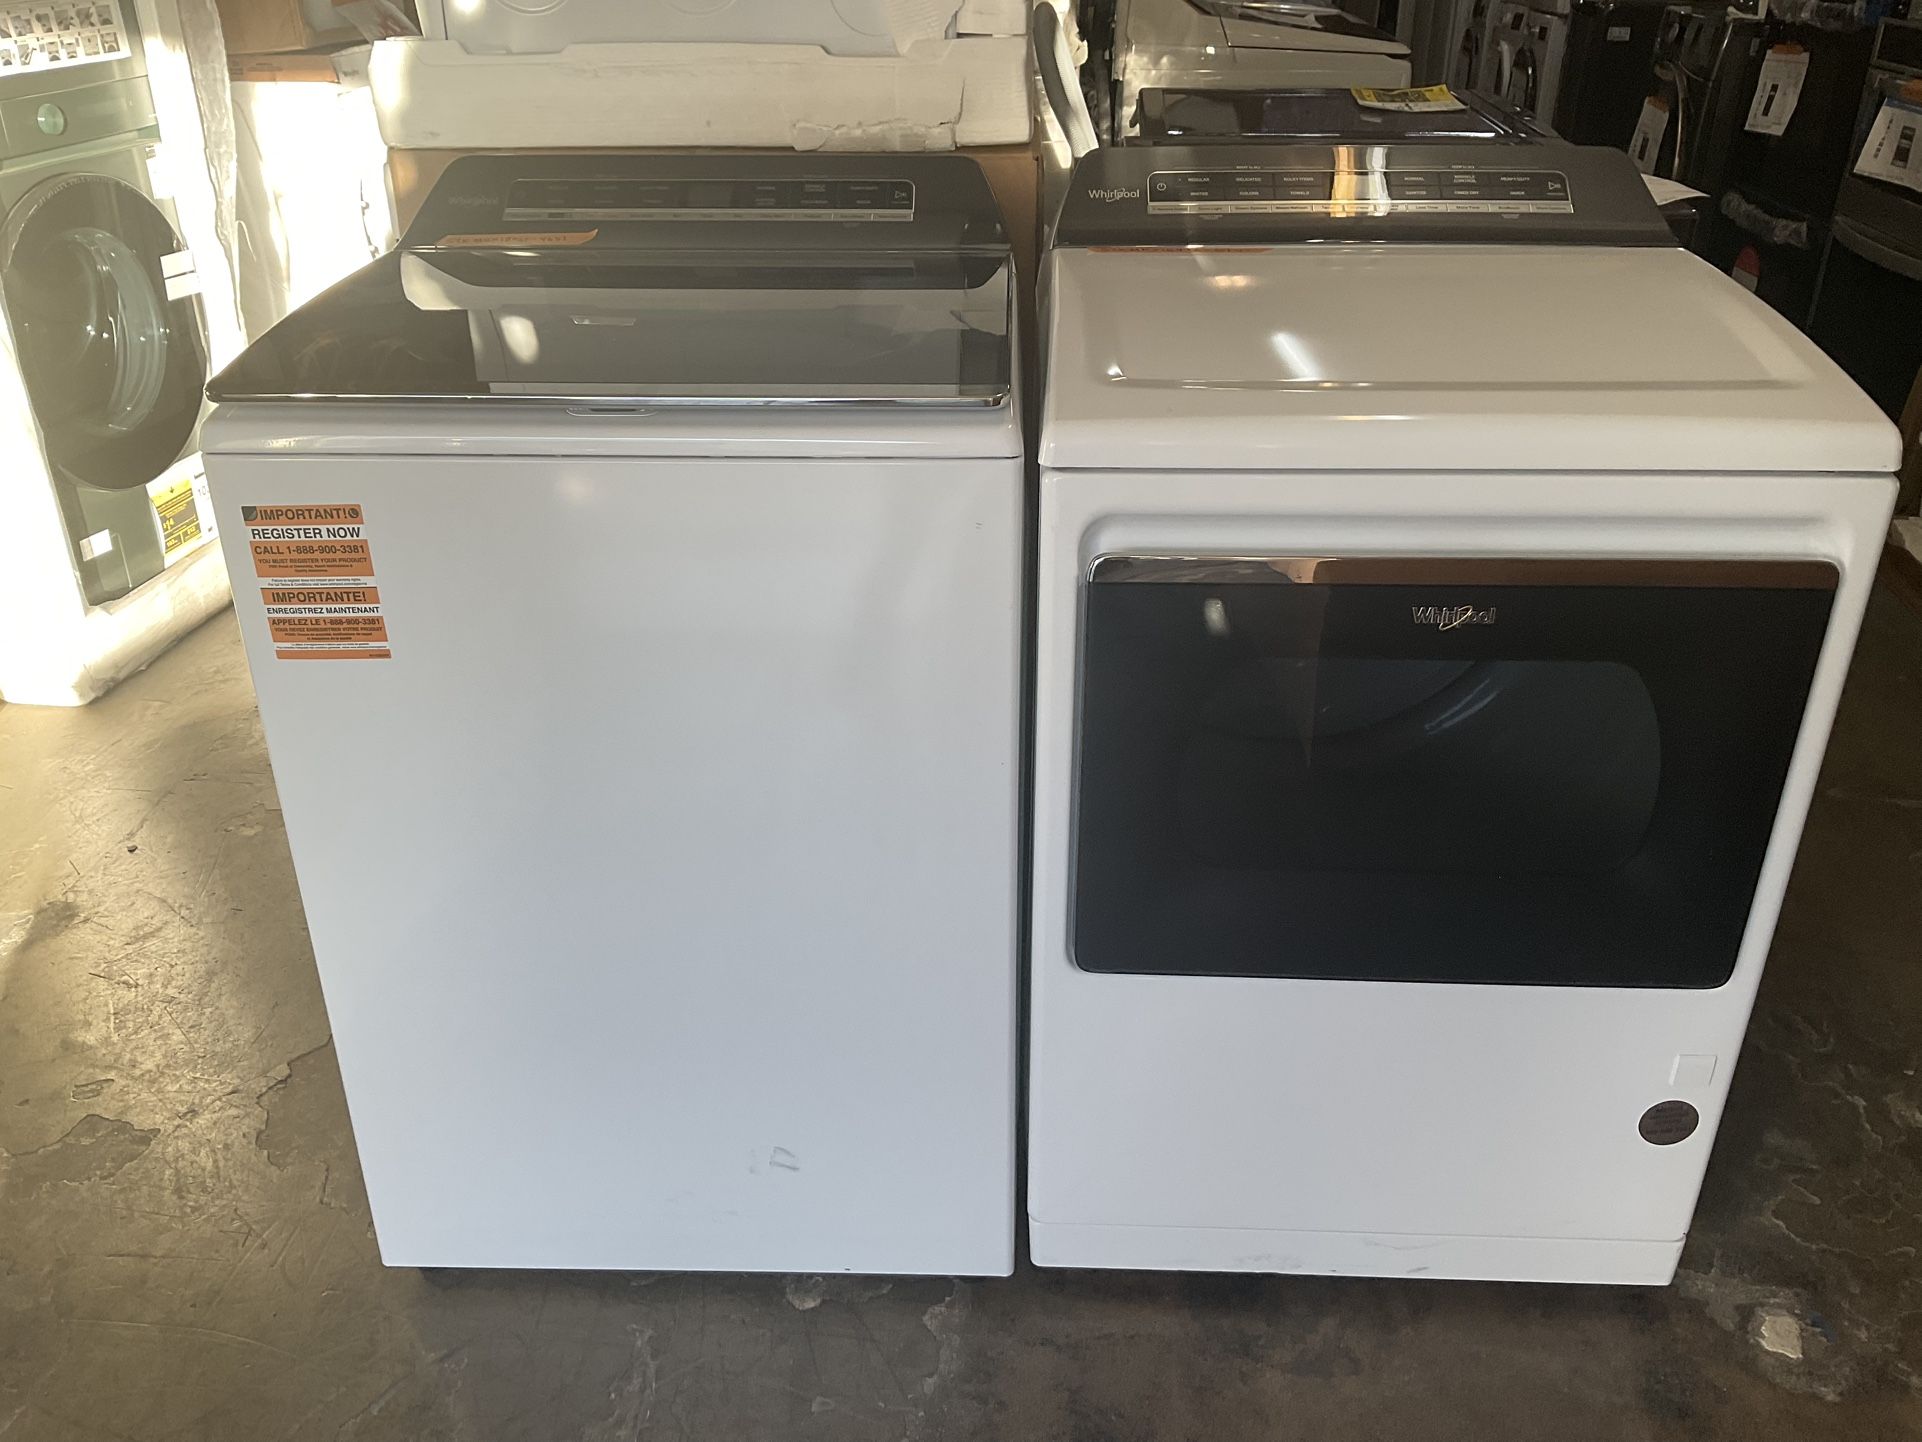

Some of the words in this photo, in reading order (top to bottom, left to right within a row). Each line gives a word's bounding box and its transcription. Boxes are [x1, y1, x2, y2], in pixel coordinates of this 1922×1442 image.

[1088, 188, 1140, 202] Whirlpool
[260, 507, 348, 521] IMPORTANT!
[252, 527, 323, 540] REGISTER
[326, 527, 361, 538] NOW
[254, 546, 284, 555] CALL
[286, 544, 366, 554] 1-888-900-3381
[272, 592, 366, 602] IMPORTANTE!
[1412, 605, 1496, 631] Whirlpool
